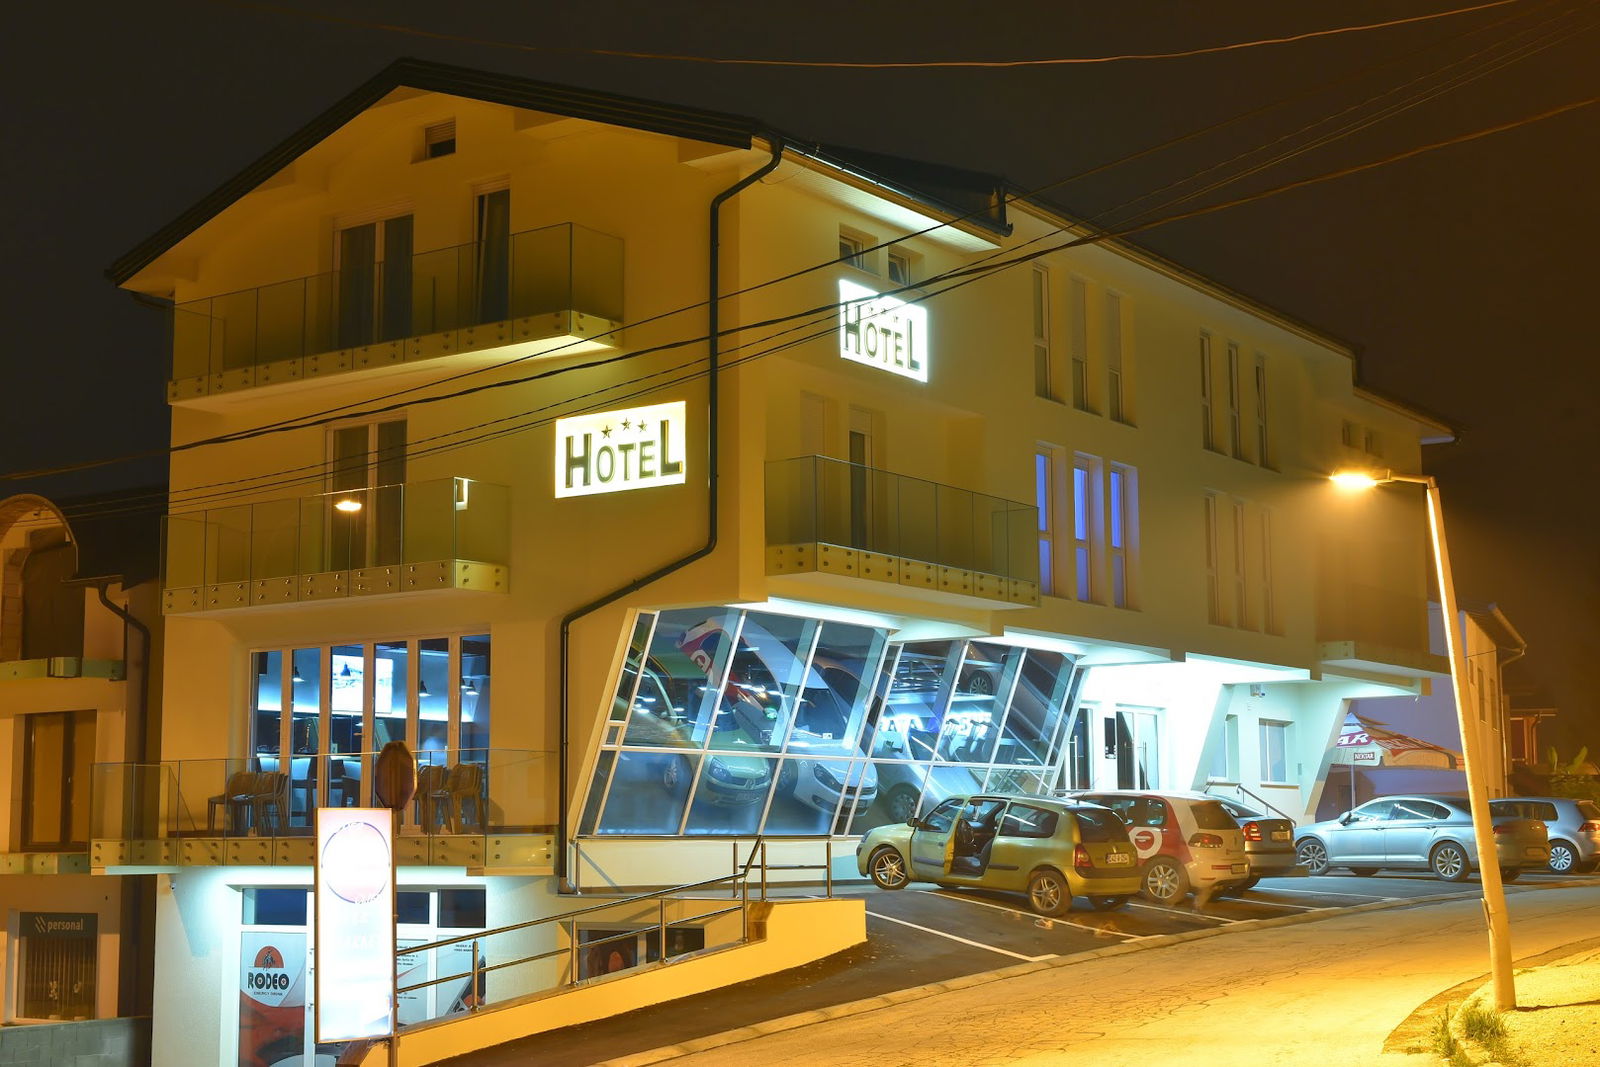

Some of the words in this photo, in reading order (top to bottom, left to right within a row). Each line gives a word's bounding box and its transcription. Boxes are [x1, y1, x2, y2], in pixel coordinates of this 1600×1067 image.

[844, 301, 920, 371] HOTEL
[565, 419, 683, 488] HOTEL
[47, 917, 83, 933] personal
[247, 972, 290, 990] RODEO
